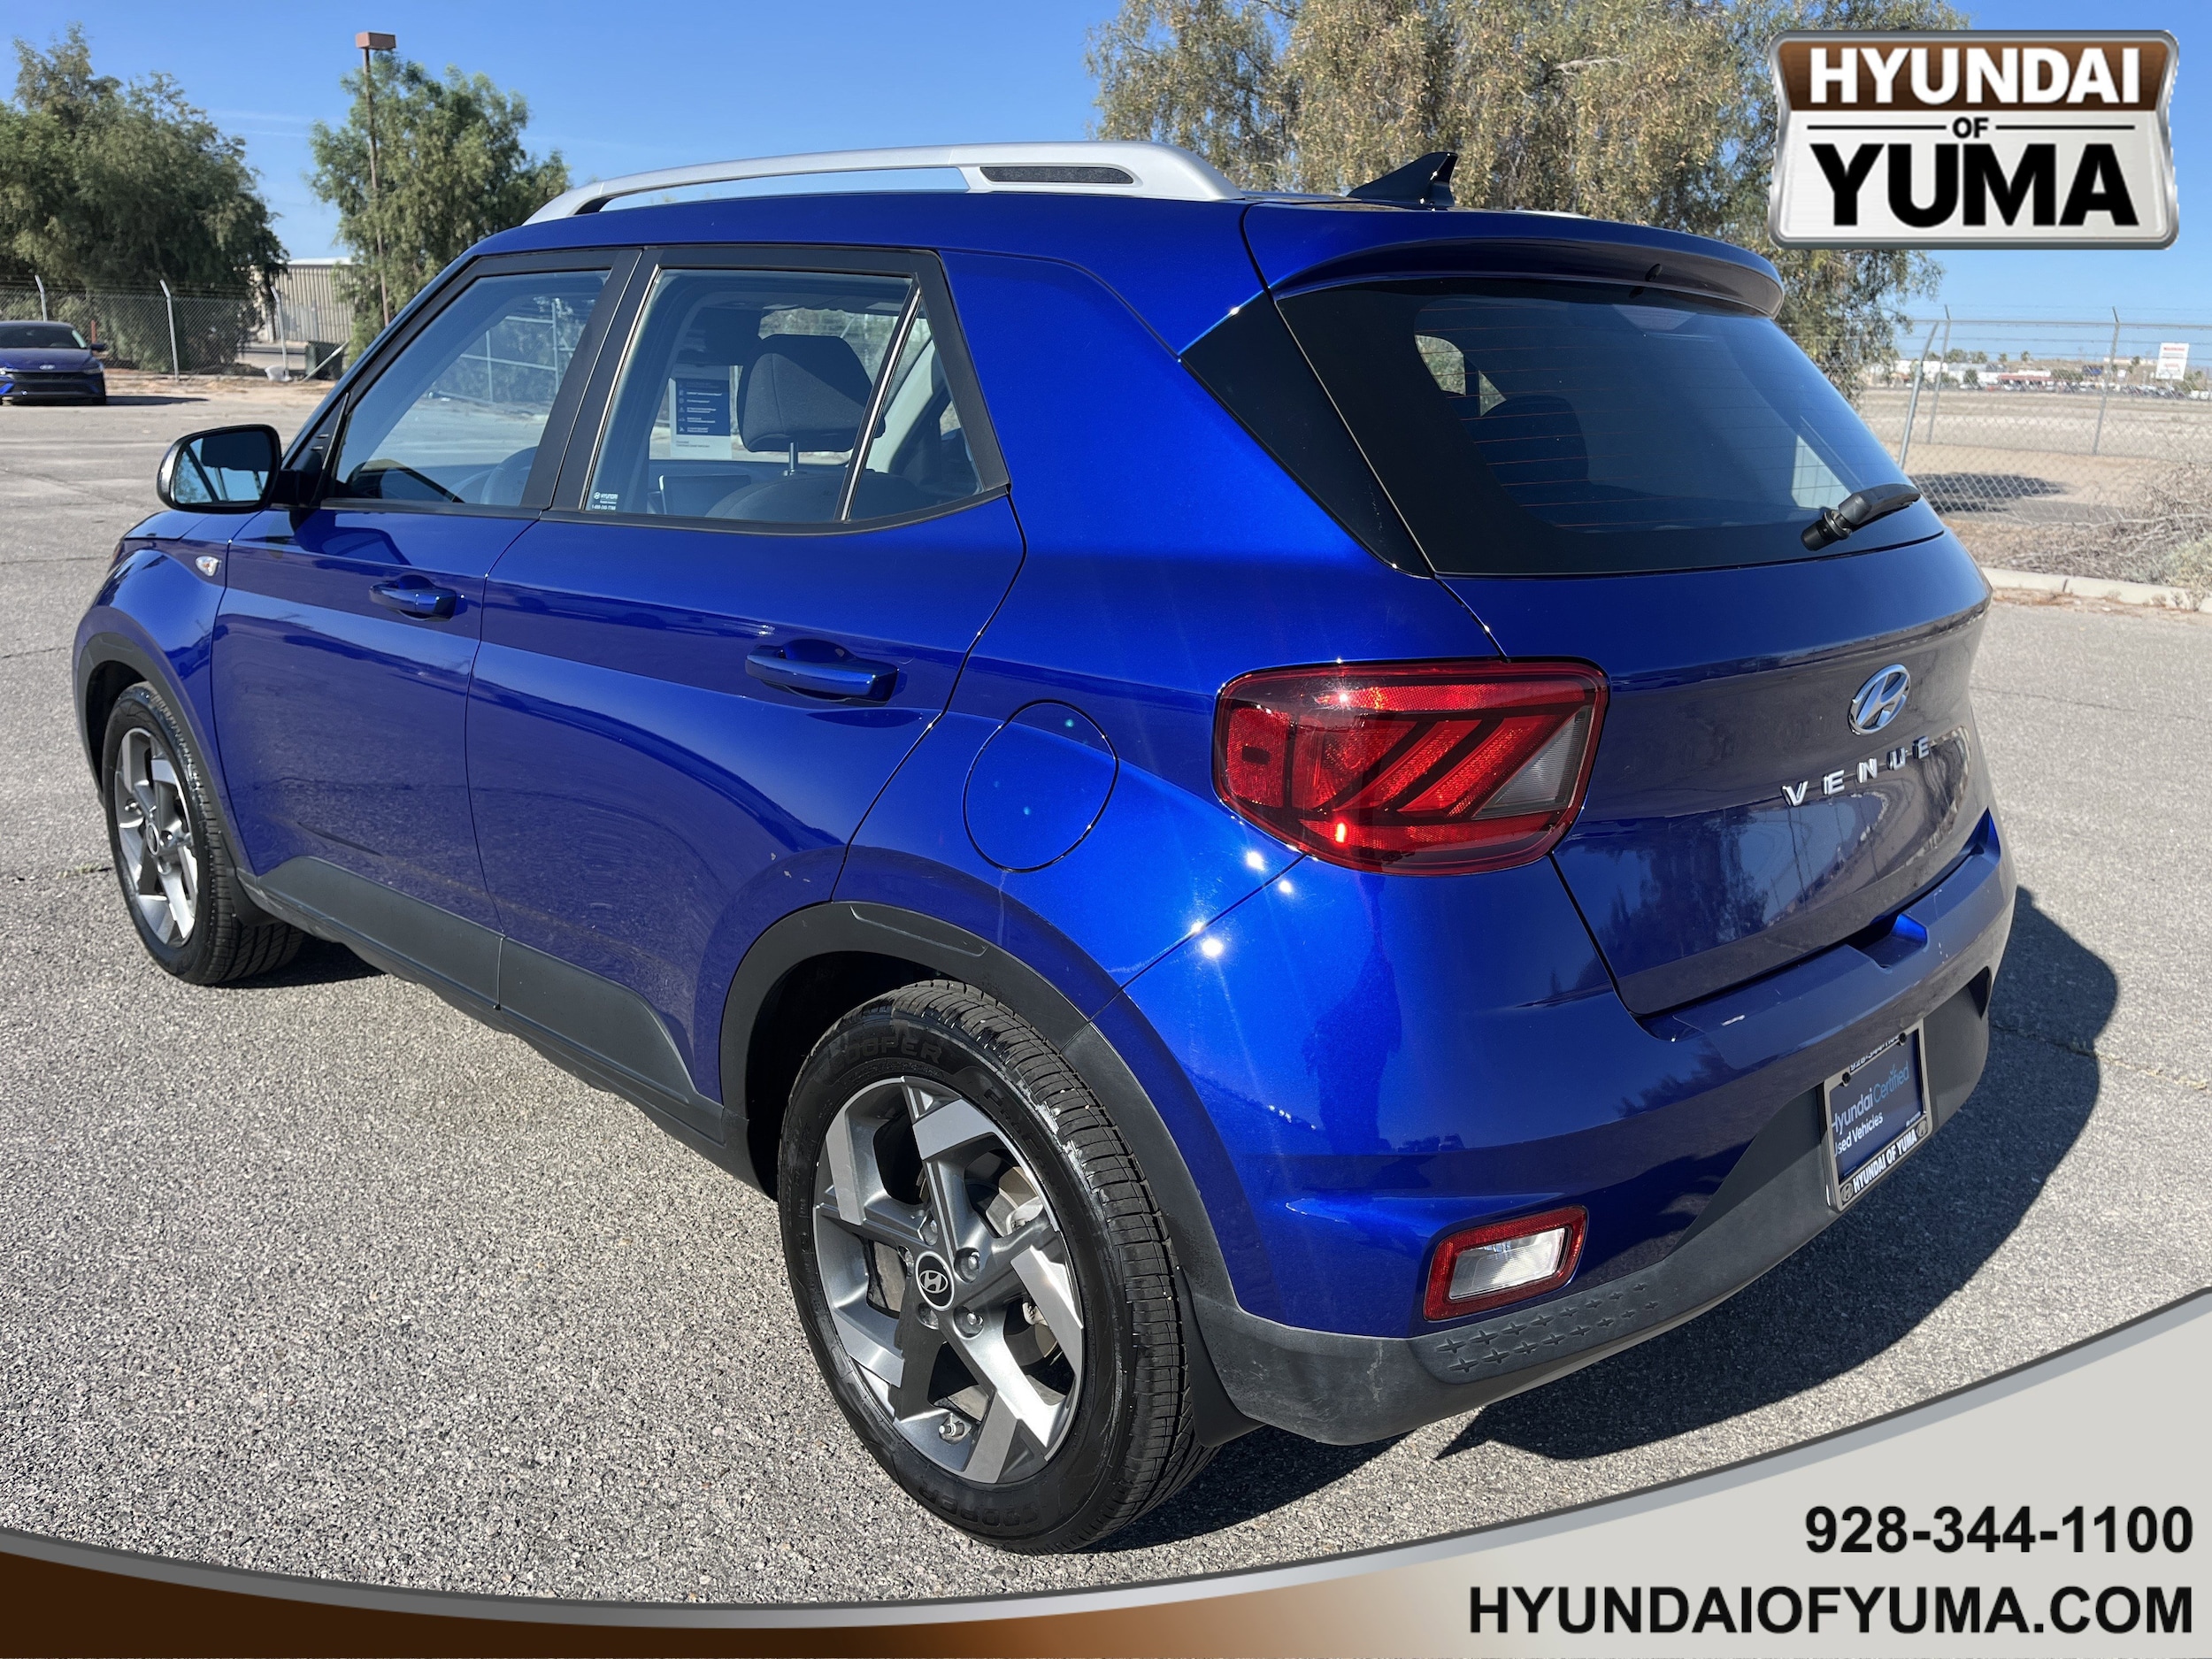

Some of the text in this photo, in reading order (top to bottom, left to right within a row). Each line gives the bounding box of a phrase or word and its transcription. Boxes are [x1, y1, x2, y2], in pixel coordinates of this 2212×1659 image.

[1781, 735, 1930, 807] VENUE
[1873, 1060, 1910, 1103] Certified
[1852, 1111, 1884, 1143] Vehicles
[1853, 1154, 1887, 1194] HYUNDAI
[1886, 1144, 1896, 1164] OF
[1896, 1128, 1917, 1156] YUMA
